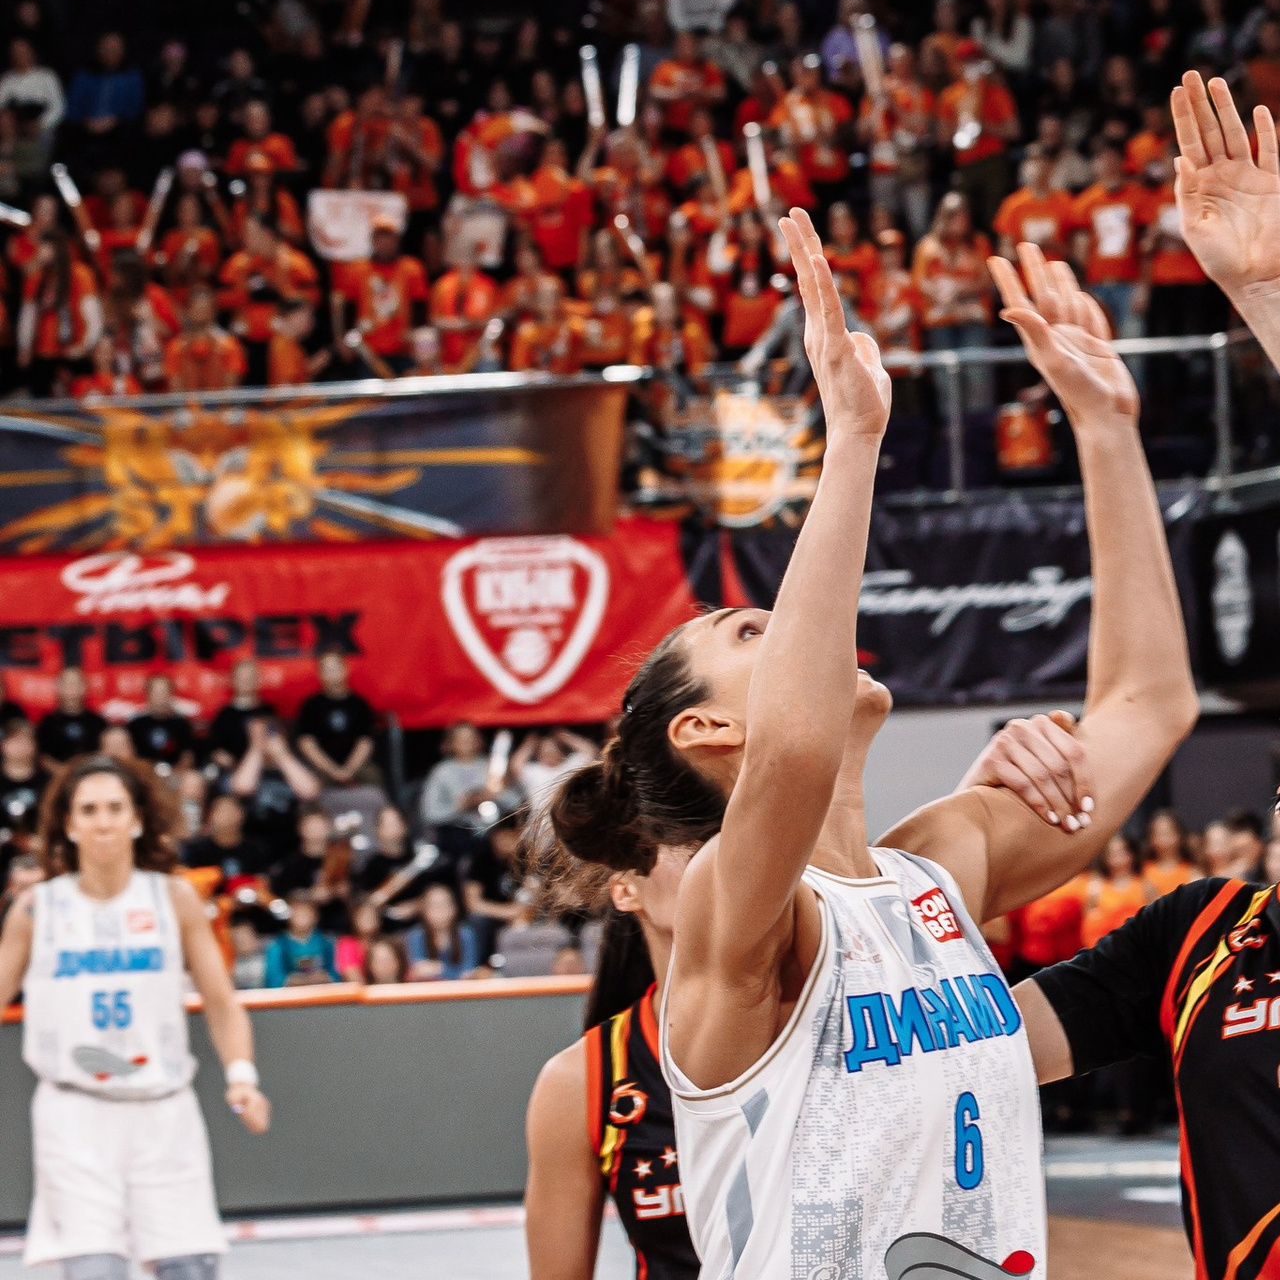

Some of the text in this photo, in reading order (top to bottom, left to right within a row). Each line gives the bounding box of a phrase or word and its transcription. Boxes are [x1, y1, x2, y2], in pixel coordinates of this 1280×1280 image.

[925, 912, 959, 939] BET
[91, 990, 133, 1030] 55
[843, 972, 1021, 1073] ДИНАМО
[955, 1091, 984, 1190] 6
